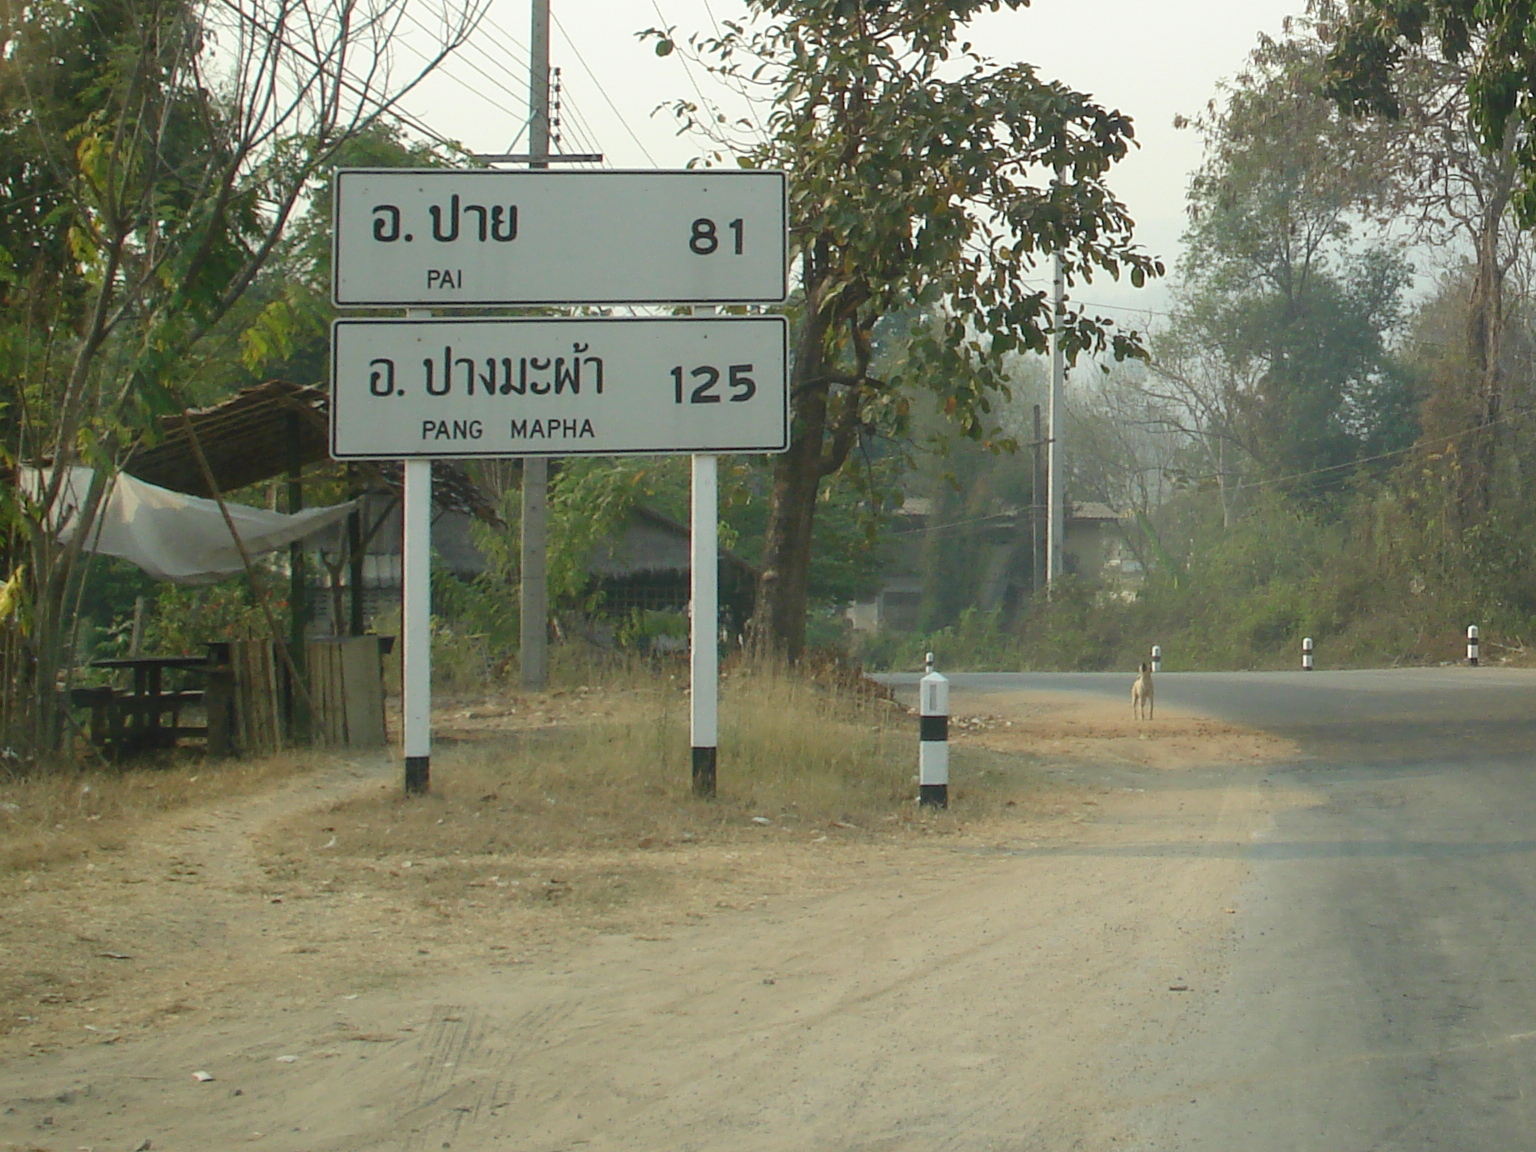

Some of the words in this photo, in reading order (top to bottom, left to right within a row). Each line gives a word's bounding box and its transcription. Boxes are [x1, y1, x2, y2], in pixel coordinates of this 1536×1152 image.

[371, 204, 415, 243] อ.
[428, 193, 518, 243] ปาย
[688, 217, 744, 256] 81
[427, 269, 462, 290] PAI
[369, 357, 407, 398] อ.
[422, 341, 604, 397] ปางมะผ้า
[670, 363, 757, 405] 125
[421, 420, 484, 441] PANG
[510, 418, 596, 440] MAPHA
